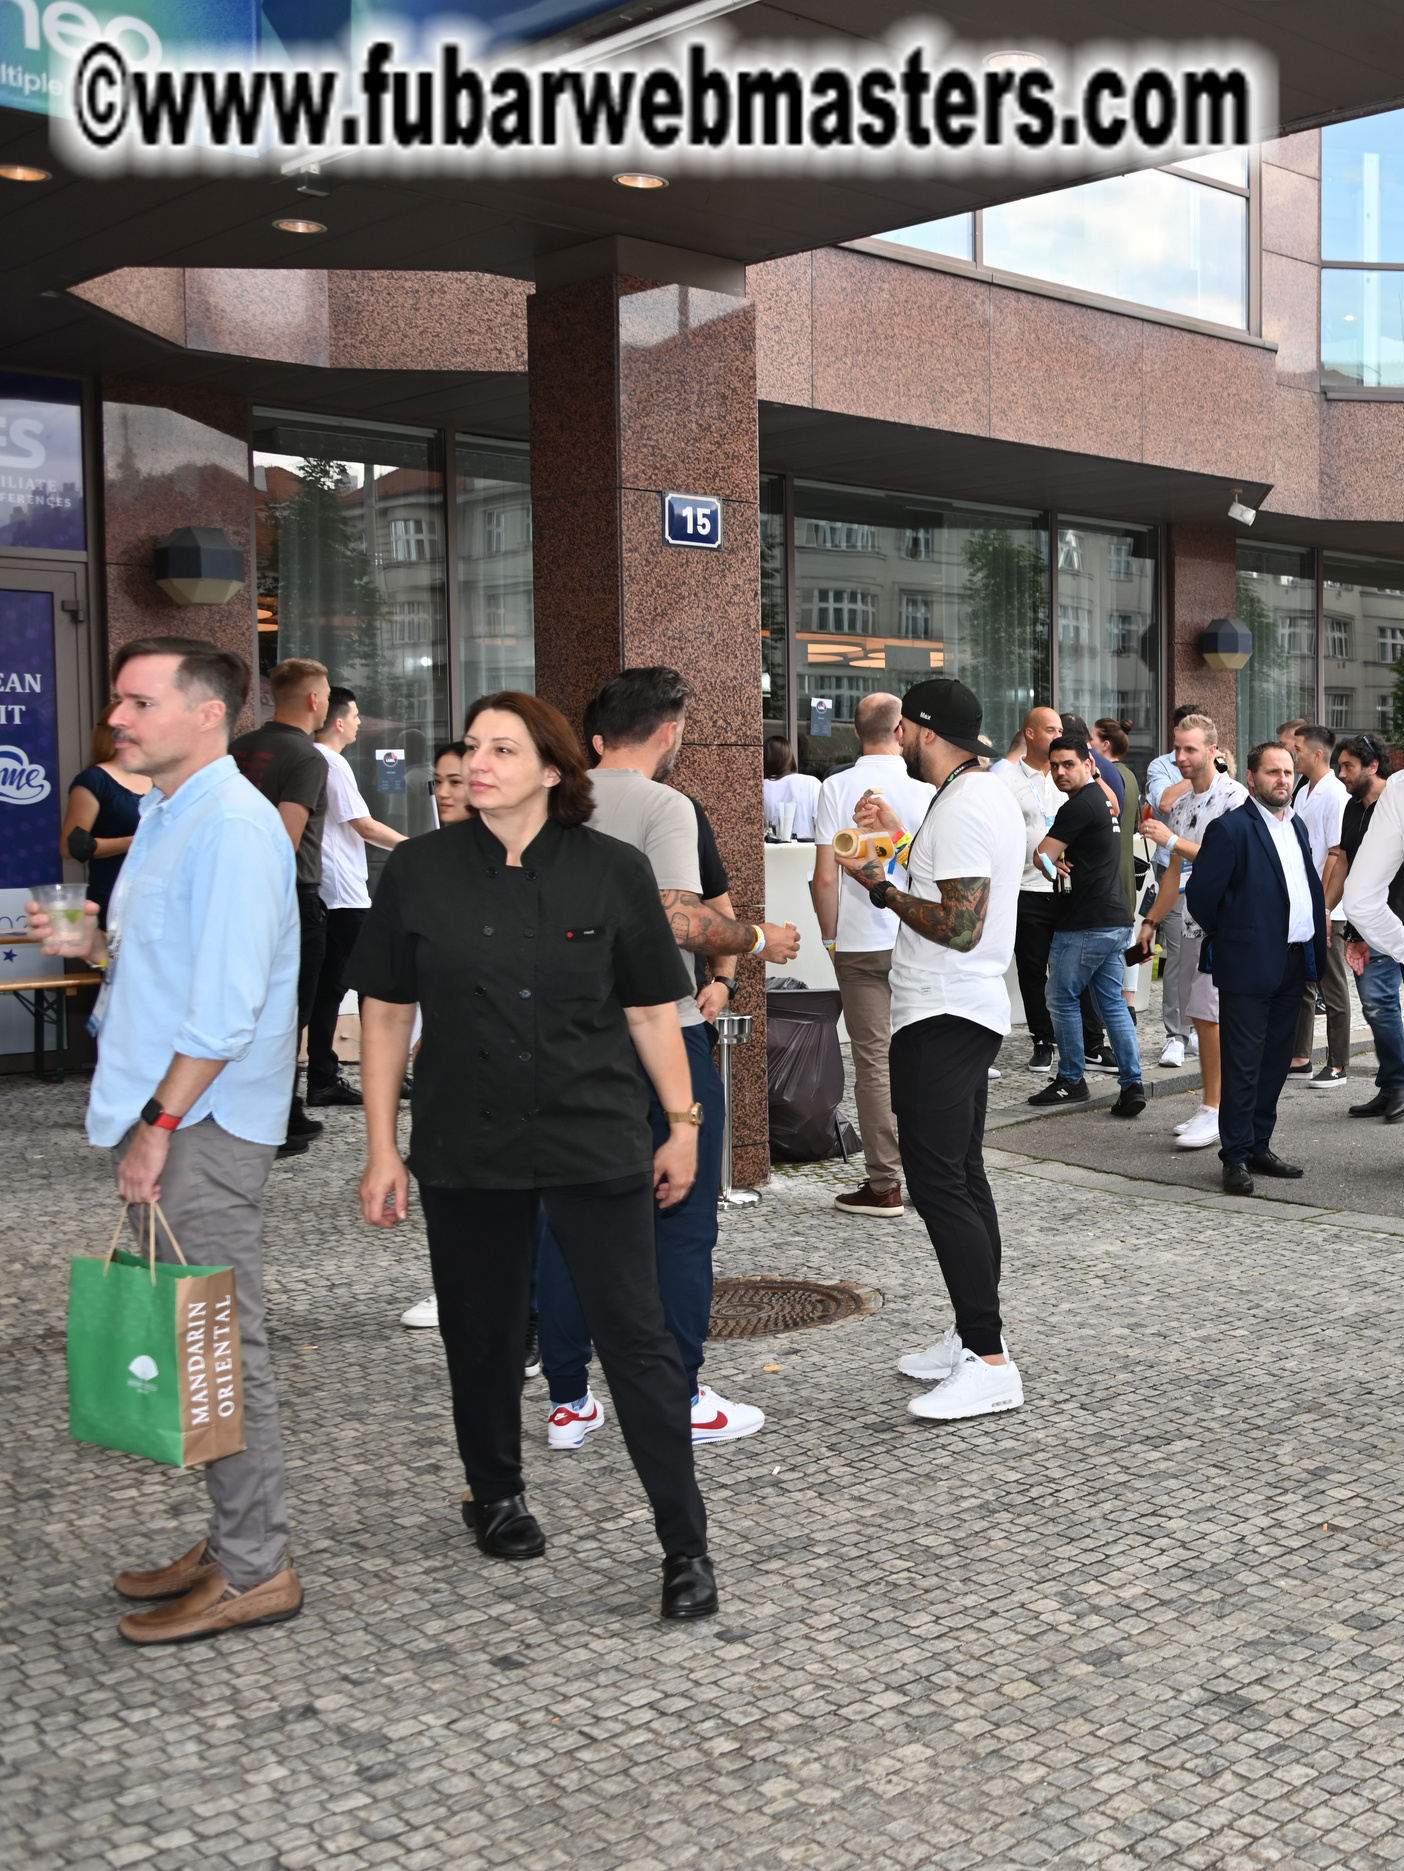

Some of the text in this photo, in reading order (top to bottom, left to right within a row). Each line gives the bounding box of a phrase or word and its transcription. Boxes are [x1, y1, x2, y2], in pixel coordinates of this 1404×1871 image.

[0, 416, 46, 469] S
[682, 506, 711, 535] 15
[0, 673, 41, 693] AN
[186, 1302, 210, 1426] MANDARIN
[213, 1294, 235, 1418] ORIENTAL
